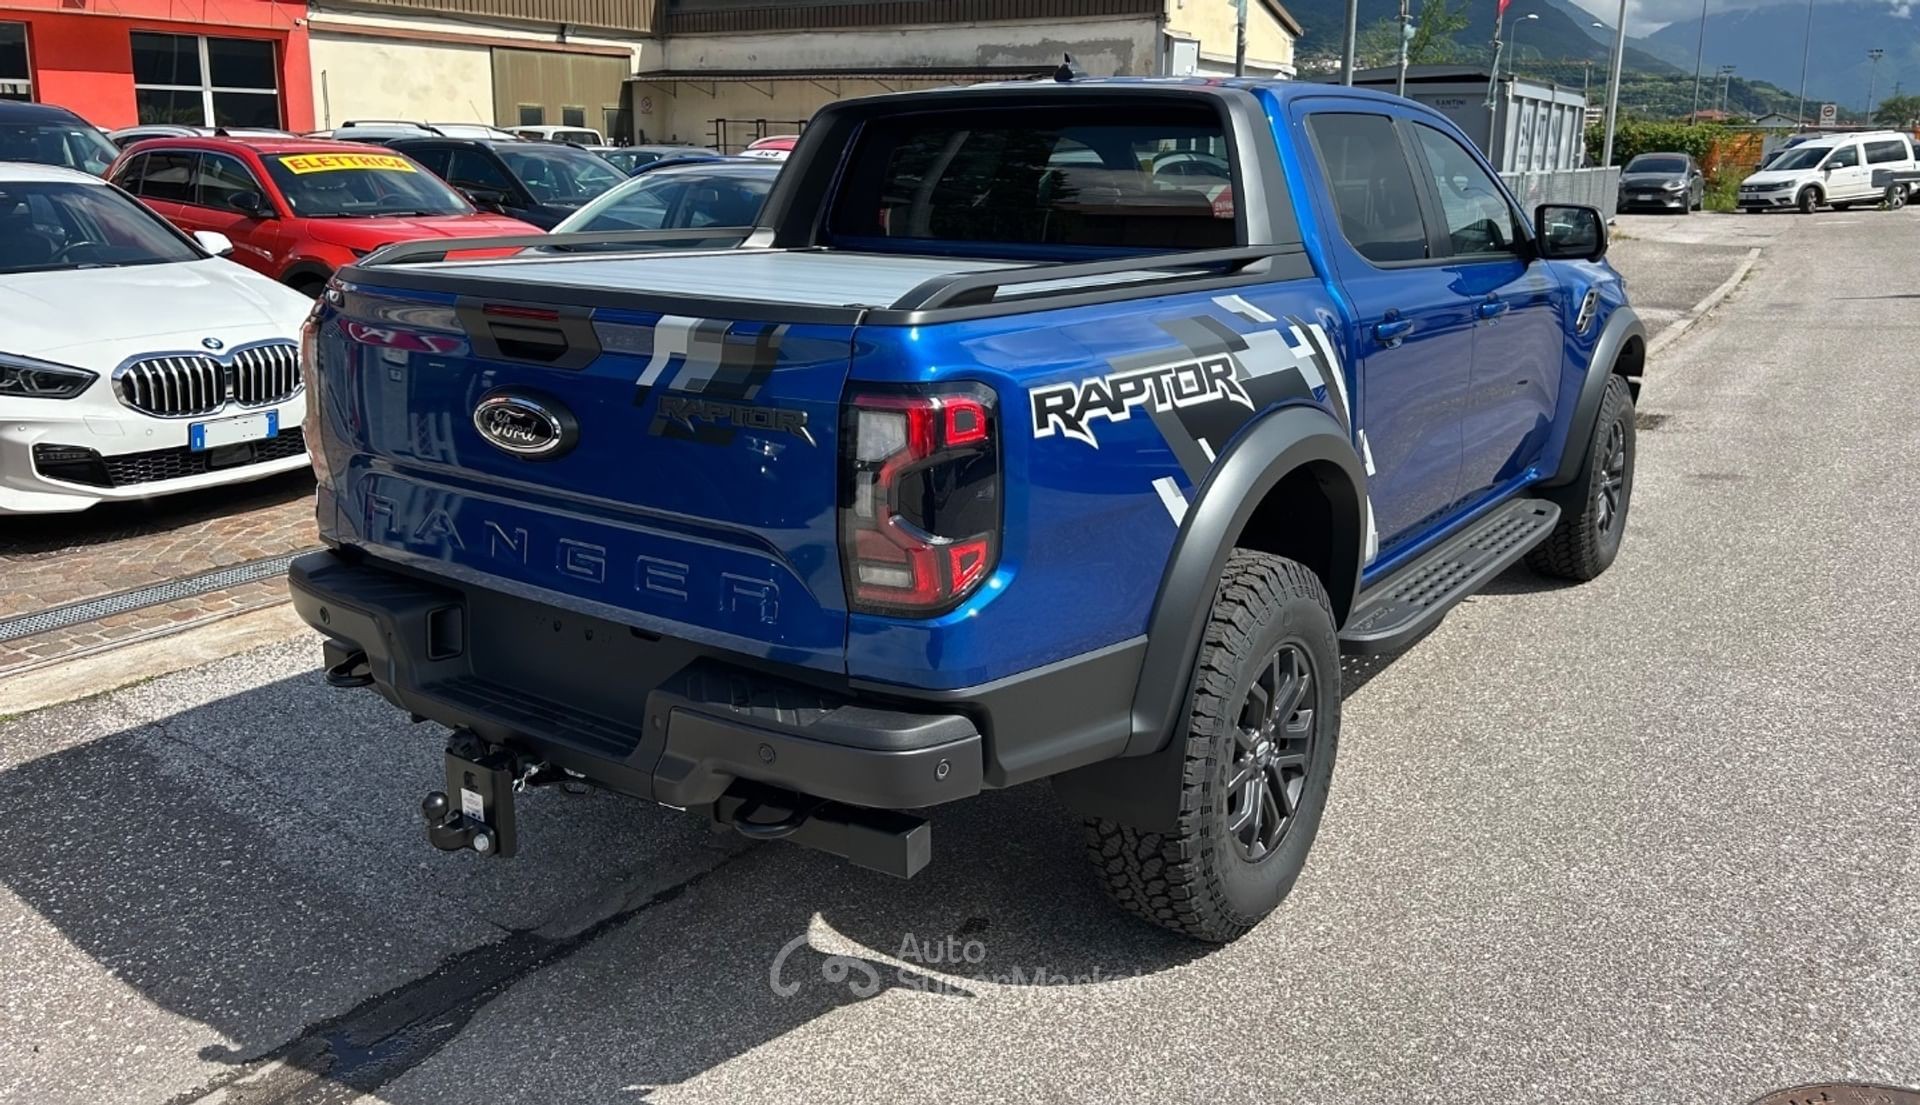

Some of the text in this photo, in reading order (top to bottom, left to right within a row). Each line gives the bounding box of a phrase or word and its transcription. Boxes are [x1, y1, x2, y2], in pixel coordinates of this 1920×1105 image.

[287, 156, 408, 170] ELETTRICA
[490, 408, 537, 441] Ford
[658, 395, 817, 447] RAPTOR
[1029, 353, 1256, 450] RAPTOR
[364, 490, 780, 625] RANGER
